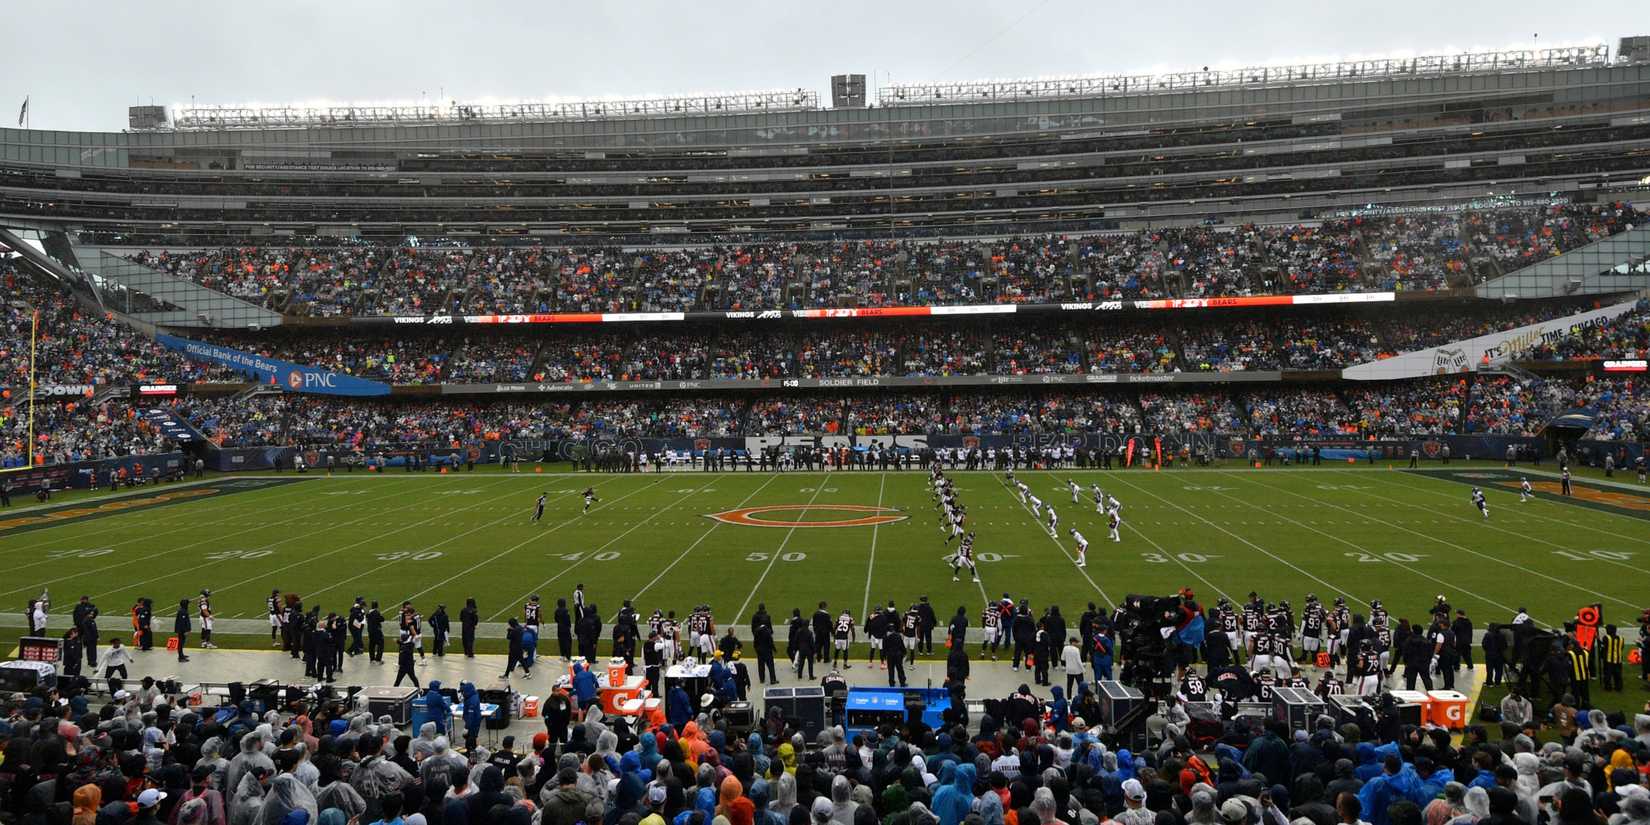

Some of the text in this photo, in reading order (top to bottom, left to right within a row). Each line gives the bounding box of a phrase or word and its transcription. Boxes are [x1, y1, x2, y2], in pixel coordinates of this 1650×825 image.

[394, 316, 424, 324] VIKINGS
[186, 343, 277, 373] Official Bank of the Bears
[305, 373, 336, 387] PNC
[375, 551, 443, 561] 30
[559, 551, 622, 562] 40
[745, 551, 807, 562] 50
[1143, 552, 1209, 563] 30
[1344, 551, 1422, 563] 20
[837, 620, 849, 632] 25
[986, 615, 997, 627] 20
[1225, 620, 1236, 630] 94
[1247, 619, 1258, 630] 50
[1308, 617, 1321, 630] 93
[1257, 641, 1270, 652] 54
[1188, 680, 1204, 695] 58
[1327, 684, 1341, 697] 70
[1446, 705, 1460, 720] G
